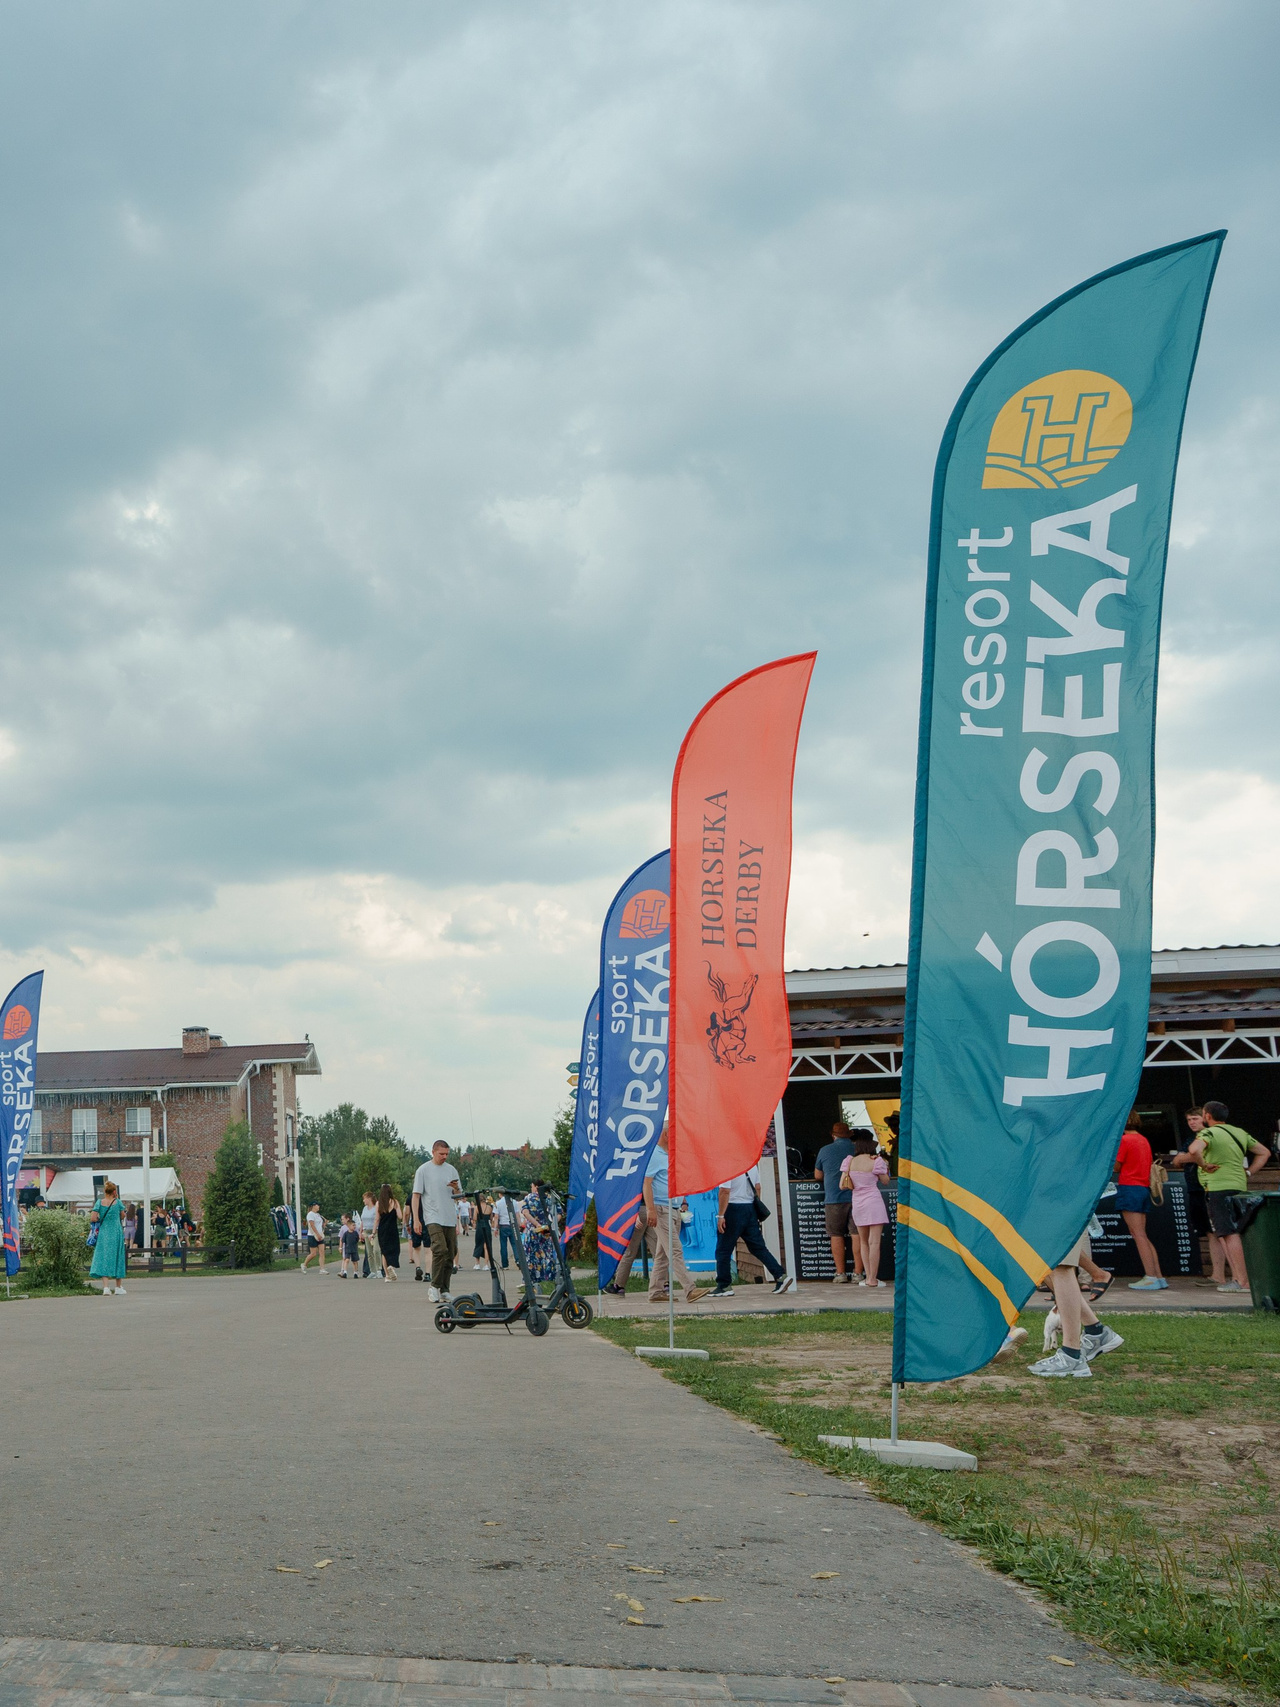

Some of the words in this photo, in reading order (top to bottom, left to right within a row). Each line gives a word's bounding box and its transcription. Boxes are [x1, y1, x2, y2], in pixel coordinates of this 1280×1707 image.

[957, 525, 1014, 738] resort
[701, 789, 729, 948] HORSEKA
[735, 839, 764, 950] DERBY
[608, 954, 633, 1034] sport
[0, 1050, 17, 1106] sport
[582, 1031, 599, 1091] sport
